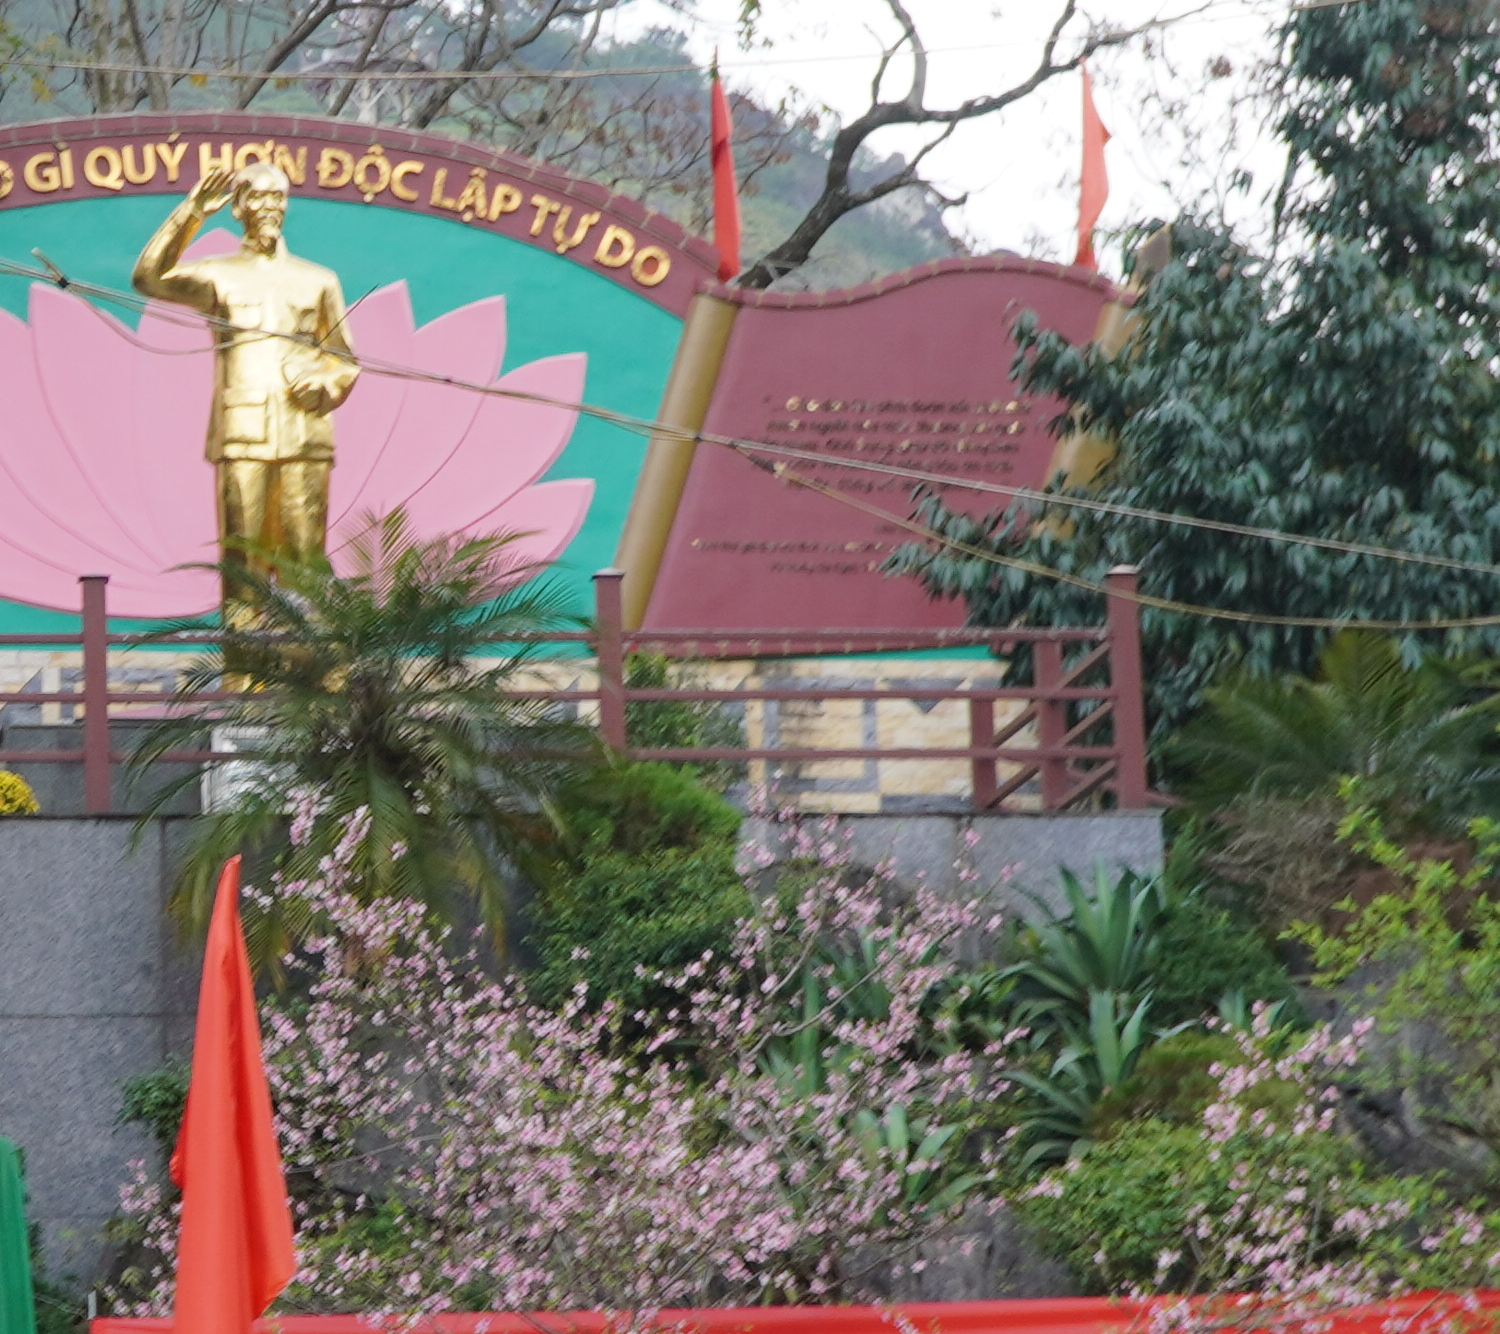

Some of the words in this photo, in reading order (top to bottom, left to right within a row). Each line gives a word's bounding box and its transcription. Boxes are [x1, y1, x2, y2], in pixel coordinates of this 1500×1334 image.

[24, 142, 74, 193] GÌ
[84, 132, 189, 191] QUÝ
[199, 139, 308, 186] HƠN
[317, 144, 424, 203] ĐỘC
[430, 168, 523, 223] LẬP
[530, 194, 601, 254] TỰ
[594, 224, 671, 287] DO
